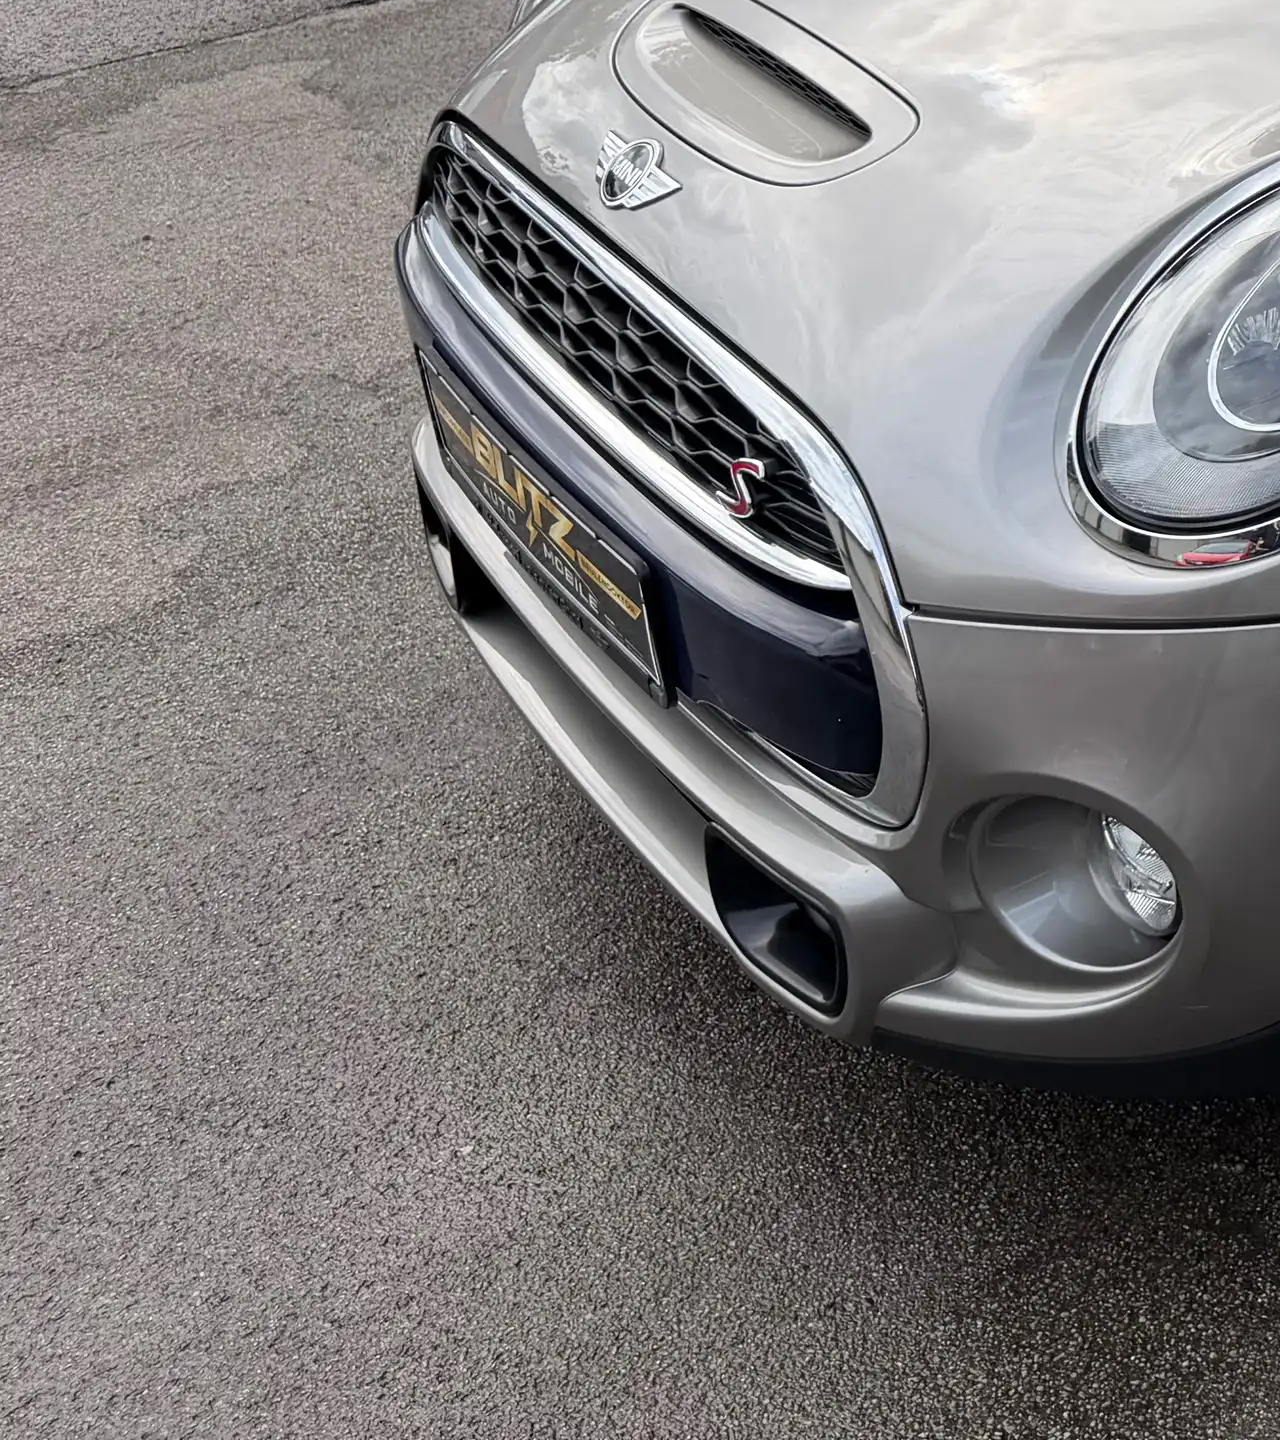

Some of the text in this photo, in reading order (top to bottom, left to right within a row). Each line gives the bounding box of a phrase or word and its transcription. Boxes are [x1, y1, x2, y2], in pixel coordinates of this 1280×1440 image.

[610, 154, 643, 187] MINI
[470, 422, 578, 562] BLITZ
[715, 458, 766, 520] S
[482, 481, 600, 615] AUTO MOBILE
